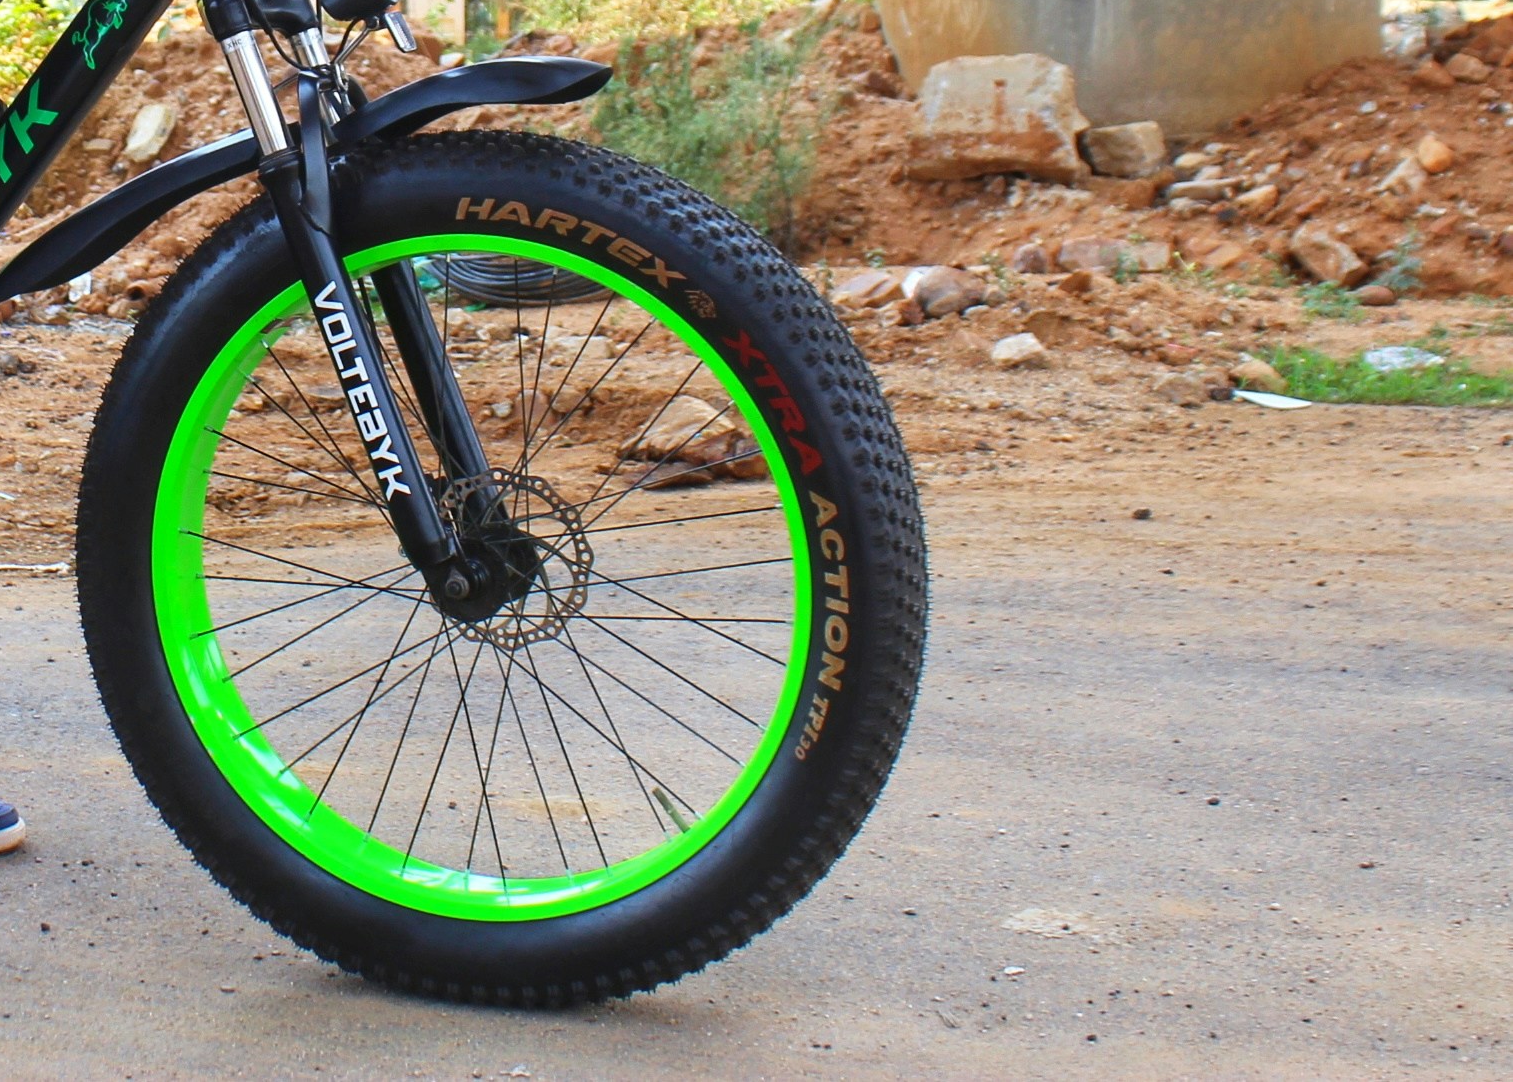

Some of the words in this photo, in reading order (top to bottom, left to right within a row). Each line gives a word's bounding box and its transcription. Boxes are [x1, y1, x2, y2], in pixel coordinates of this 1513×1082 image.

[314, 280, 412, 502] VOLTEBYK
[455, 196, 688, 289] HARTEX
[722, 328, 823, 476] XTRA
[809, 489, 851, 692] ACTION
